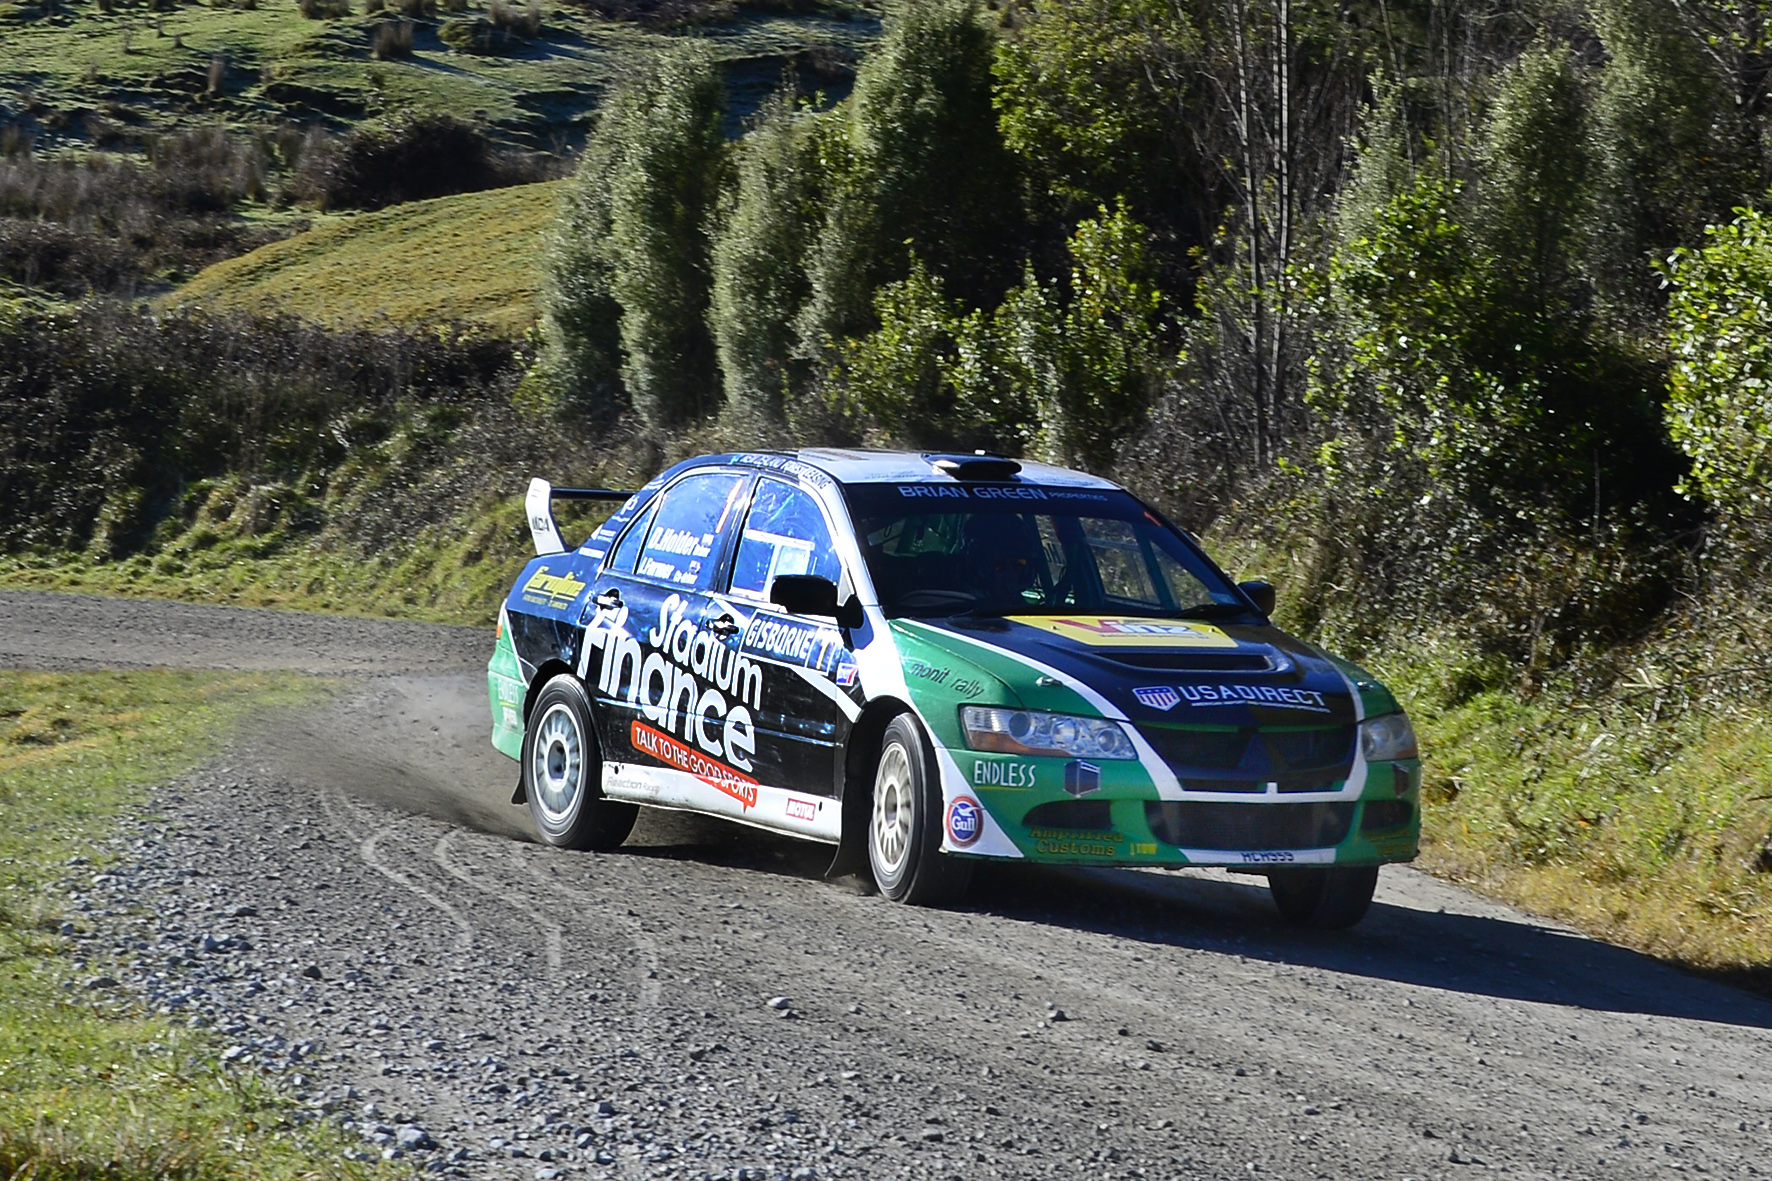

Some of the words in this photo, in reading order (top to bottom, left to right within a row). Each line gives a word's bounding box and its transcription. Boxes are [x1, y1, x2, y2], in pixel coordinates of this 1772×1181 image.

[898, 486, 970, 499] BRIAN
[973, 487, 1048, 501] GREEN
[650, 593, 763, 711] Stadium
[745, 618, 815, 661] GISBORNE
[577, 602, 756, 773] Finance
[908, 663, 951, 684] monit
[950, 678, 985, 700] rally
[635, 727, 659, 753] TALK
[658, 738, 672, 759] TO
[672, 745, 689, 768] THE
[721, 770, 755, 802] SPORTS
[974, 759, 1036, 788] ENDLESS
[1036, 839, 1115, 857] Customs
